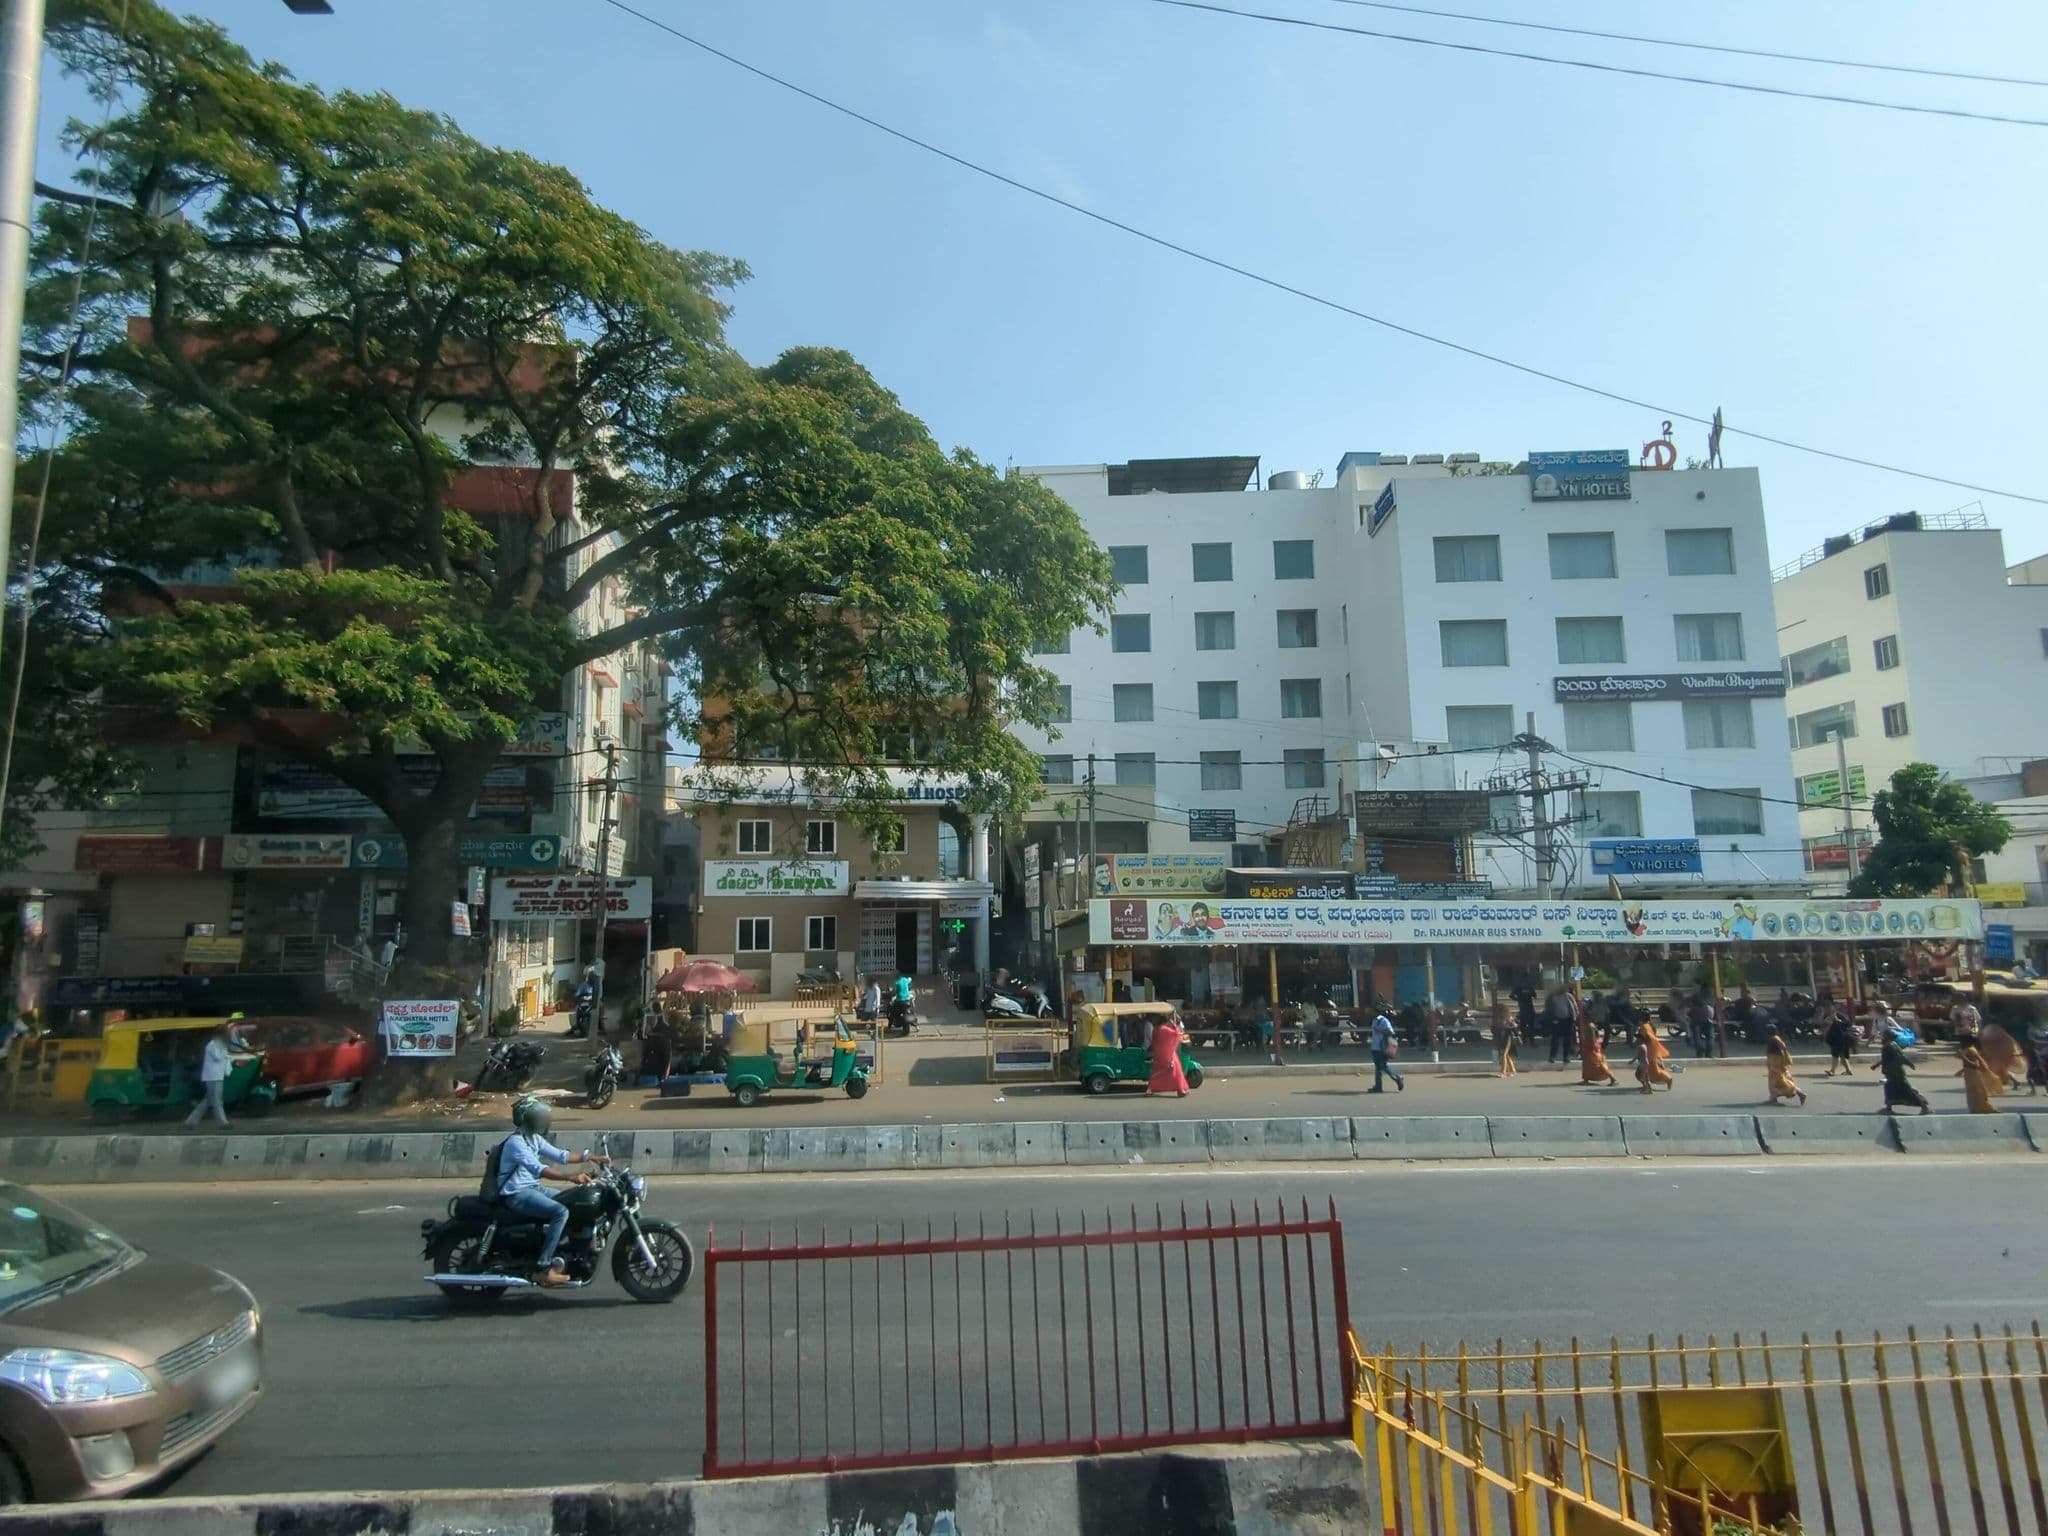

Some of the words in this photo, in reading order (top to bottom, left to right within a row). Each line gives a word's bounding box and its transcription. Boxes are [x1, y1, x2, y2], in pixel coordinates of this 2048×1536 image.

[1560, 483, 1578, 496] YN
[1582, 482, 1631, 496] HOTELS
[1557, 679, 1597, 691] ವಿಂದು
[1600, 677, 1667, 692] ಭೋಜನಂ
[1682, 676, 1724, 688] Vindhu
[1630, 860, 1645, 870] YN
[1647, 859, 1688, 870] HOTELS
[772, 877, 837, 889] DENTAL
[1221, 906, 1288, 920] ಕರ್ನಾಟಕ
[1295, 906, 1325, 926] ರತ್ನ
[1328, 906, 1405, 926] ಪದ್ಮಭೂಷಣ
[1543, 905, 1571, 921] ಬಸ್
[1577, 906, 1618, 925] ನಿಲ್ದಾಣ
[1414, 928, 1428, 937] Dr.
[1430, 928, 1485, 937] RAJKUMAR
[1488, 928, 1508, 937] BUS
[1510, 928, 1542, 937] STAND
